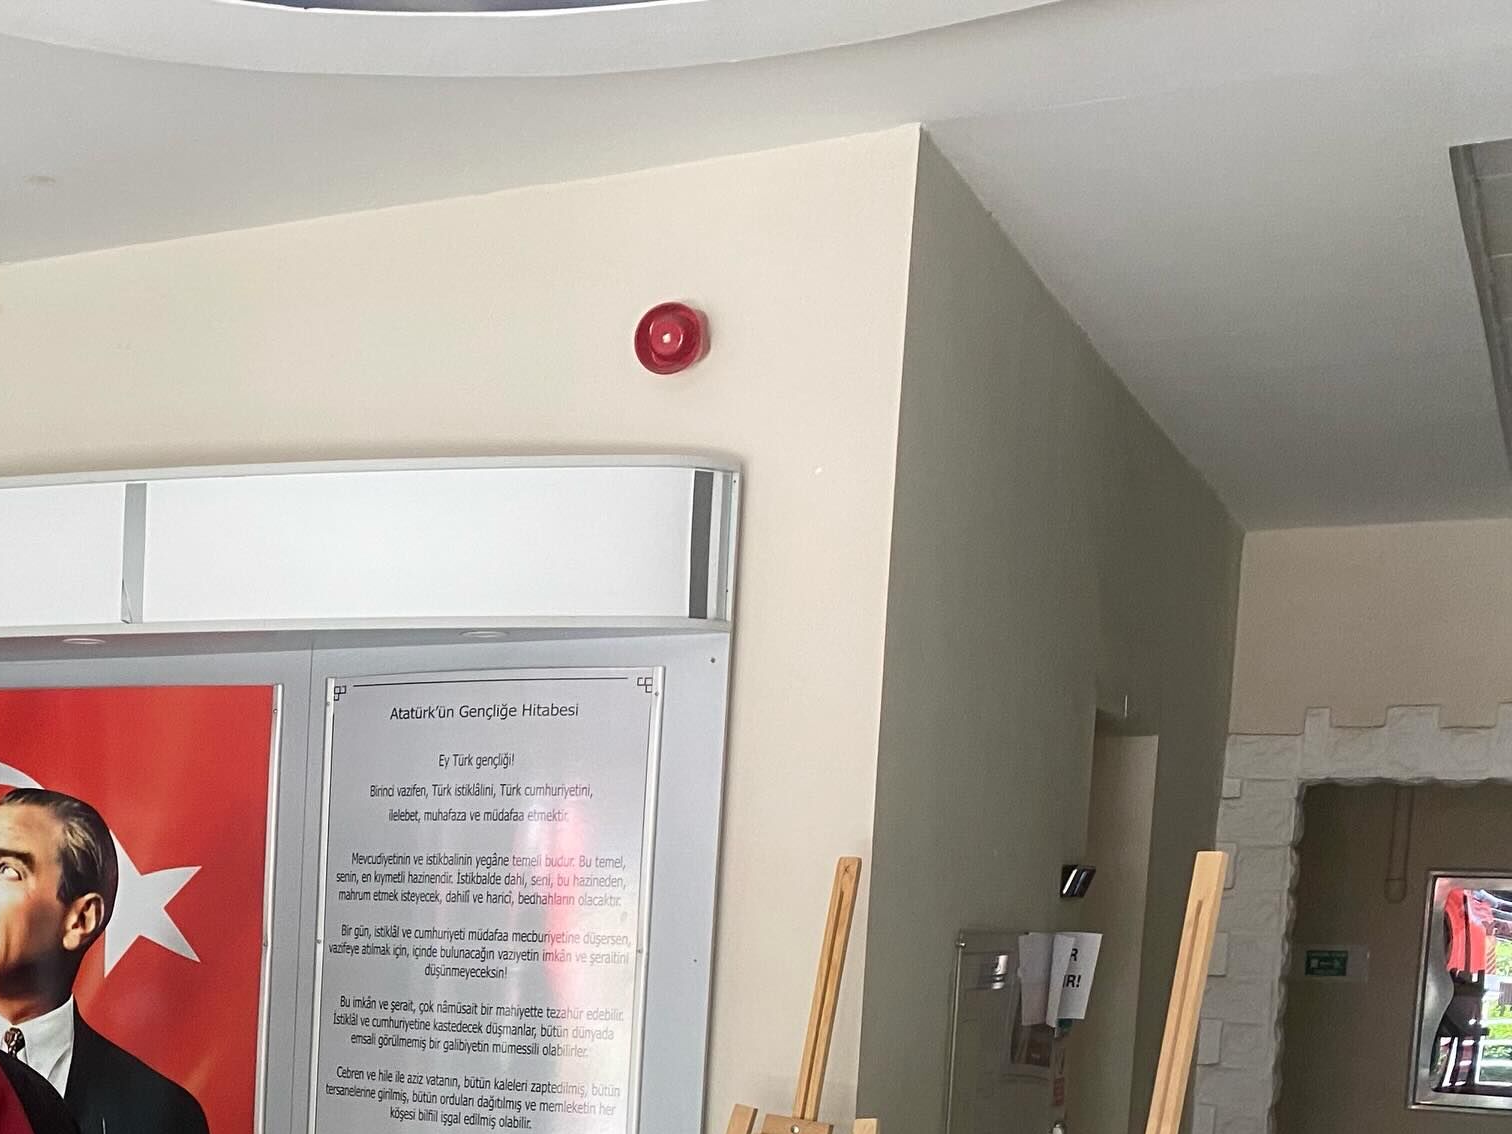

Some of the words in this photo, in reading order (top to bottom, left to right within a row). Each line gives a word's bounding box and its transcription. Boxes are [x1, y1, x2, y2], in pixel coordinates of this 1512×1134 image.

[390, 706, 455, 720] Atatürk'ün
[458, 704, 517, 720] Gençliğe
[521, 703, 579, 716] Hitabesi
[438, 754, 450, 769] Ey
[453, 754, 473, 766] Türk
[475, 752, 517, 769] gençliği!
[396, 784, 430, 799] vazifen,
[432, 784, 452, 796] Türk
[454, 783, 498, 798] istiklâlini,
[500, 784, 522, 796] Türk
[523, 784, 595, 799] cumhuriyetini,
[423, 808, 467, 821] muhafaza
[469, 808, 481, 821] ve
[483, 808, 525, 821] müdafaa
[412, 856, 424, 865] ve
[425, 853, 473, 865] istikbalinin
[475, 853, 510, 869] yegâne
[544, 854, 576, 868] budur.
[578, 855, 592, 868] Bu
[594, 856, 628, 871] temel,
[424, 963, 510, 980] düşünmeyeceksin!
[390, 1106, 416, 1122] köşesi
[440, 1111, 461, 1126] işgal
[463, 1113, 496, 1129] edilmiş
[498, 1115, 533, 1129] olabilir.
